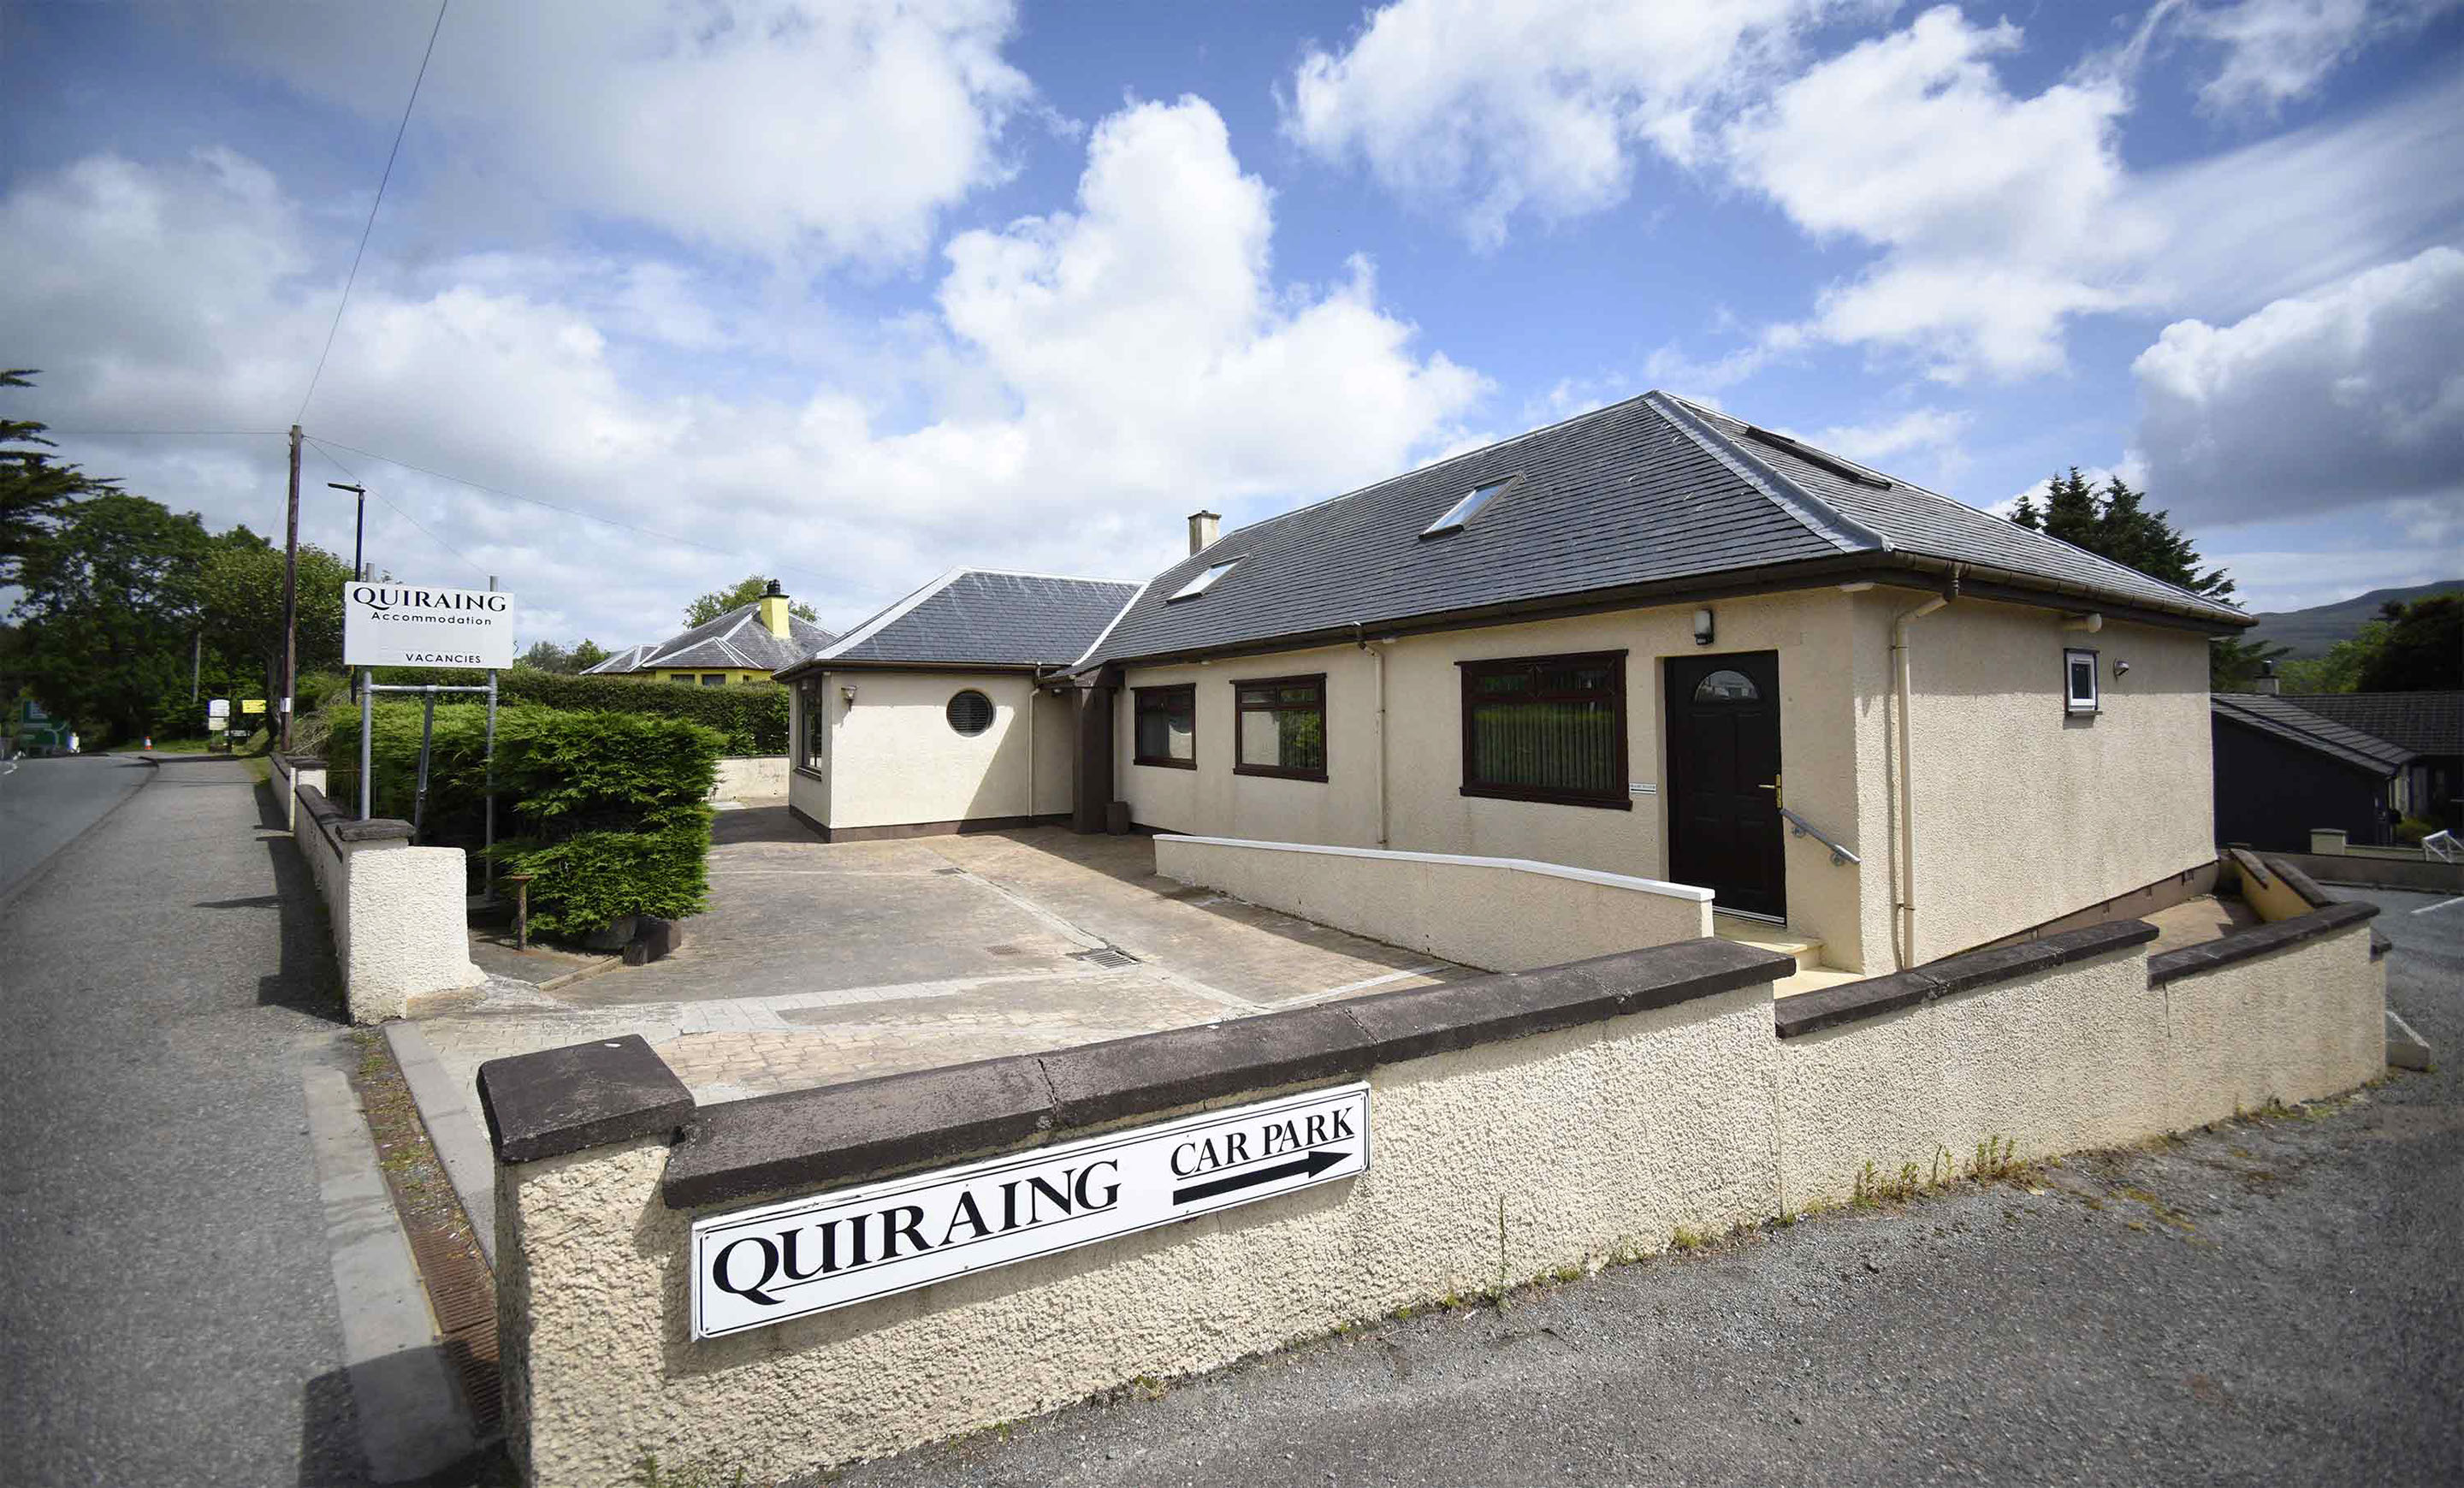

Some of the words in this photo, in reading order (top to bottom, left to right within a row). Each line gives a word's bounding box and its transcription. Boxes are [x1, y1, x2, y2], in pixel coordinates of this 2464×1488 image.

[352, 587, 506, 612] QUIRAING
[371, 611, 492, 625] Accommodation
[406, 653, 482, 664] VACANCIES
[1170, 1132, 1252, 1177] CAR
[1261, 1106, 1354, 1156] PARK
[712, 1159, 1122, 1306] QUIRAING
